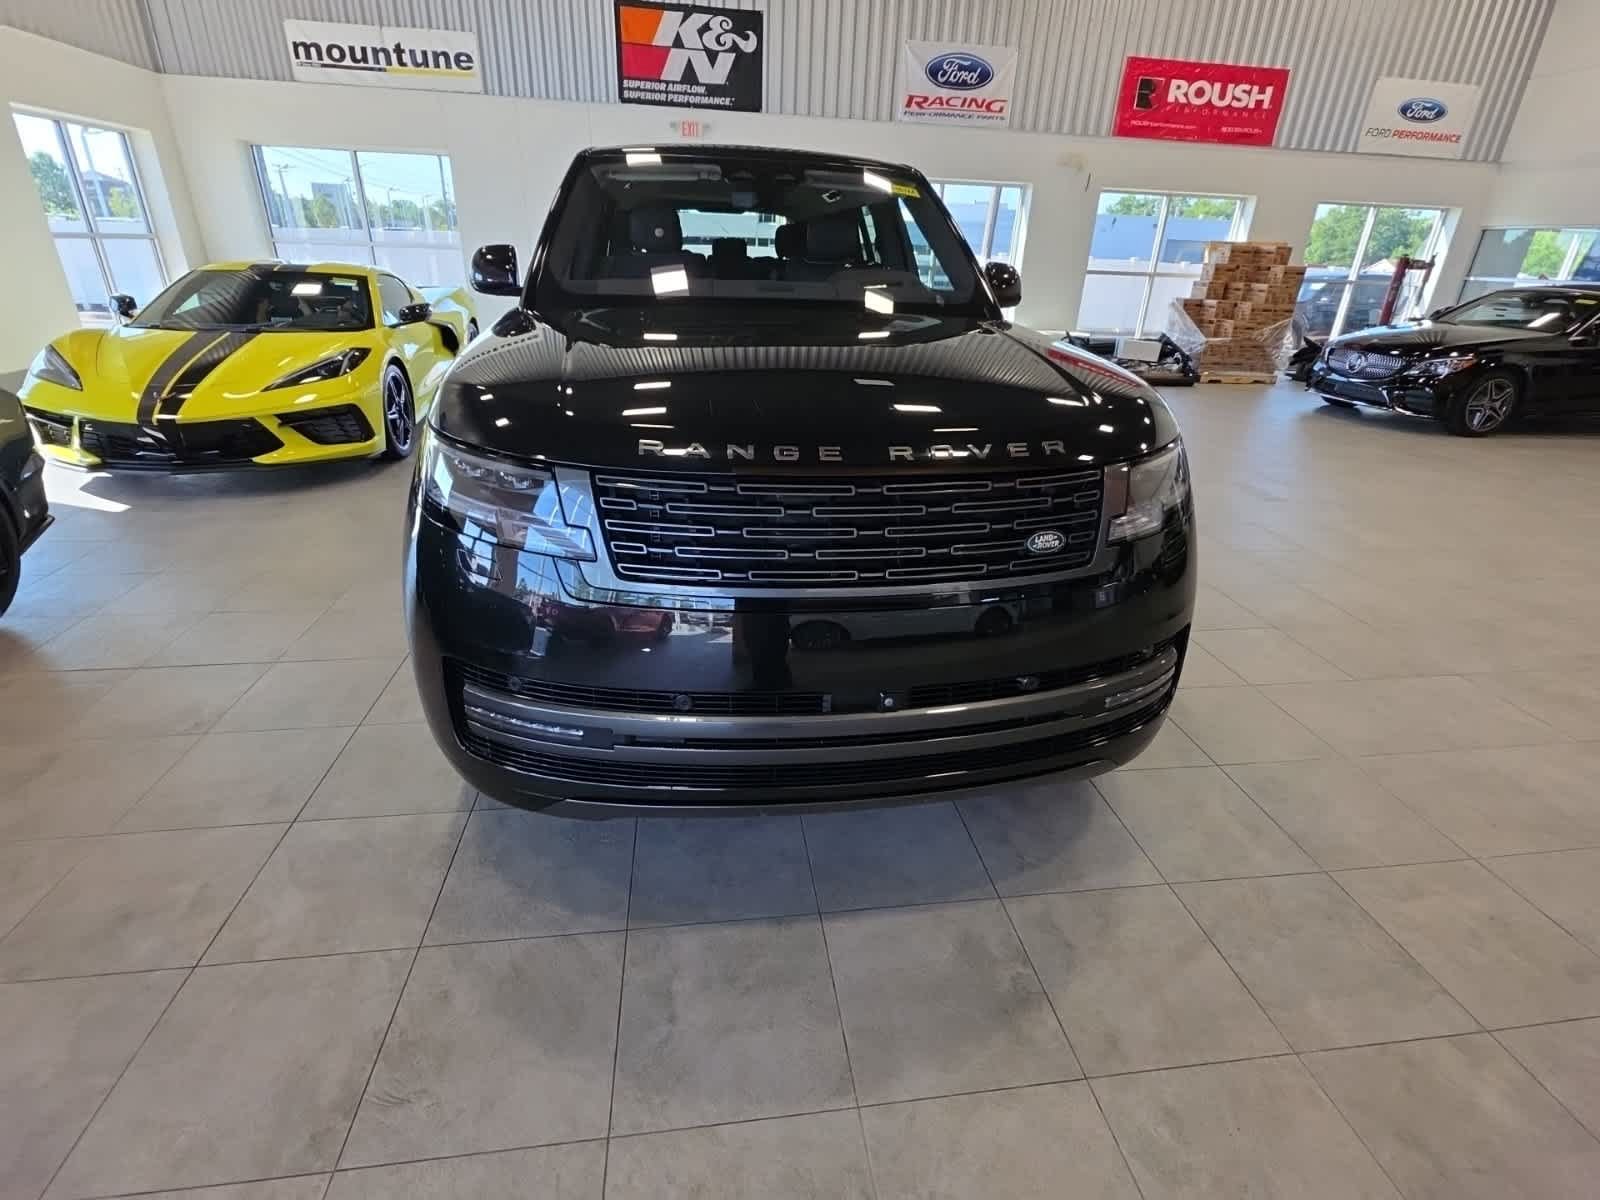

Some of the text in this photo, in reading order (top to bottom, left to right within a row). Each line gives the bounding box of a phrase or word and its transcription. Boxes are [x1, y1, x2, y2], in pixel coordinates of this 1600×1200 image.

[292, 41, 474, 71] mountune
[938, 59, 982, 84] Ford
[623, 79, 666, 91] SUPERIOR
[1167, 79, 1273, 109] ROUSH
[623, 90, 666, 102] SUPERIOR
[905, 95, 1008, 113] RACING
[1407, 102, 1440, 120] Ford
[682, 120, 699, 136] EXIT
[1365, 127, 1461, 143] FORD PERFORMANCE
[638, 438, 1066, 461] RANGE ROVER
